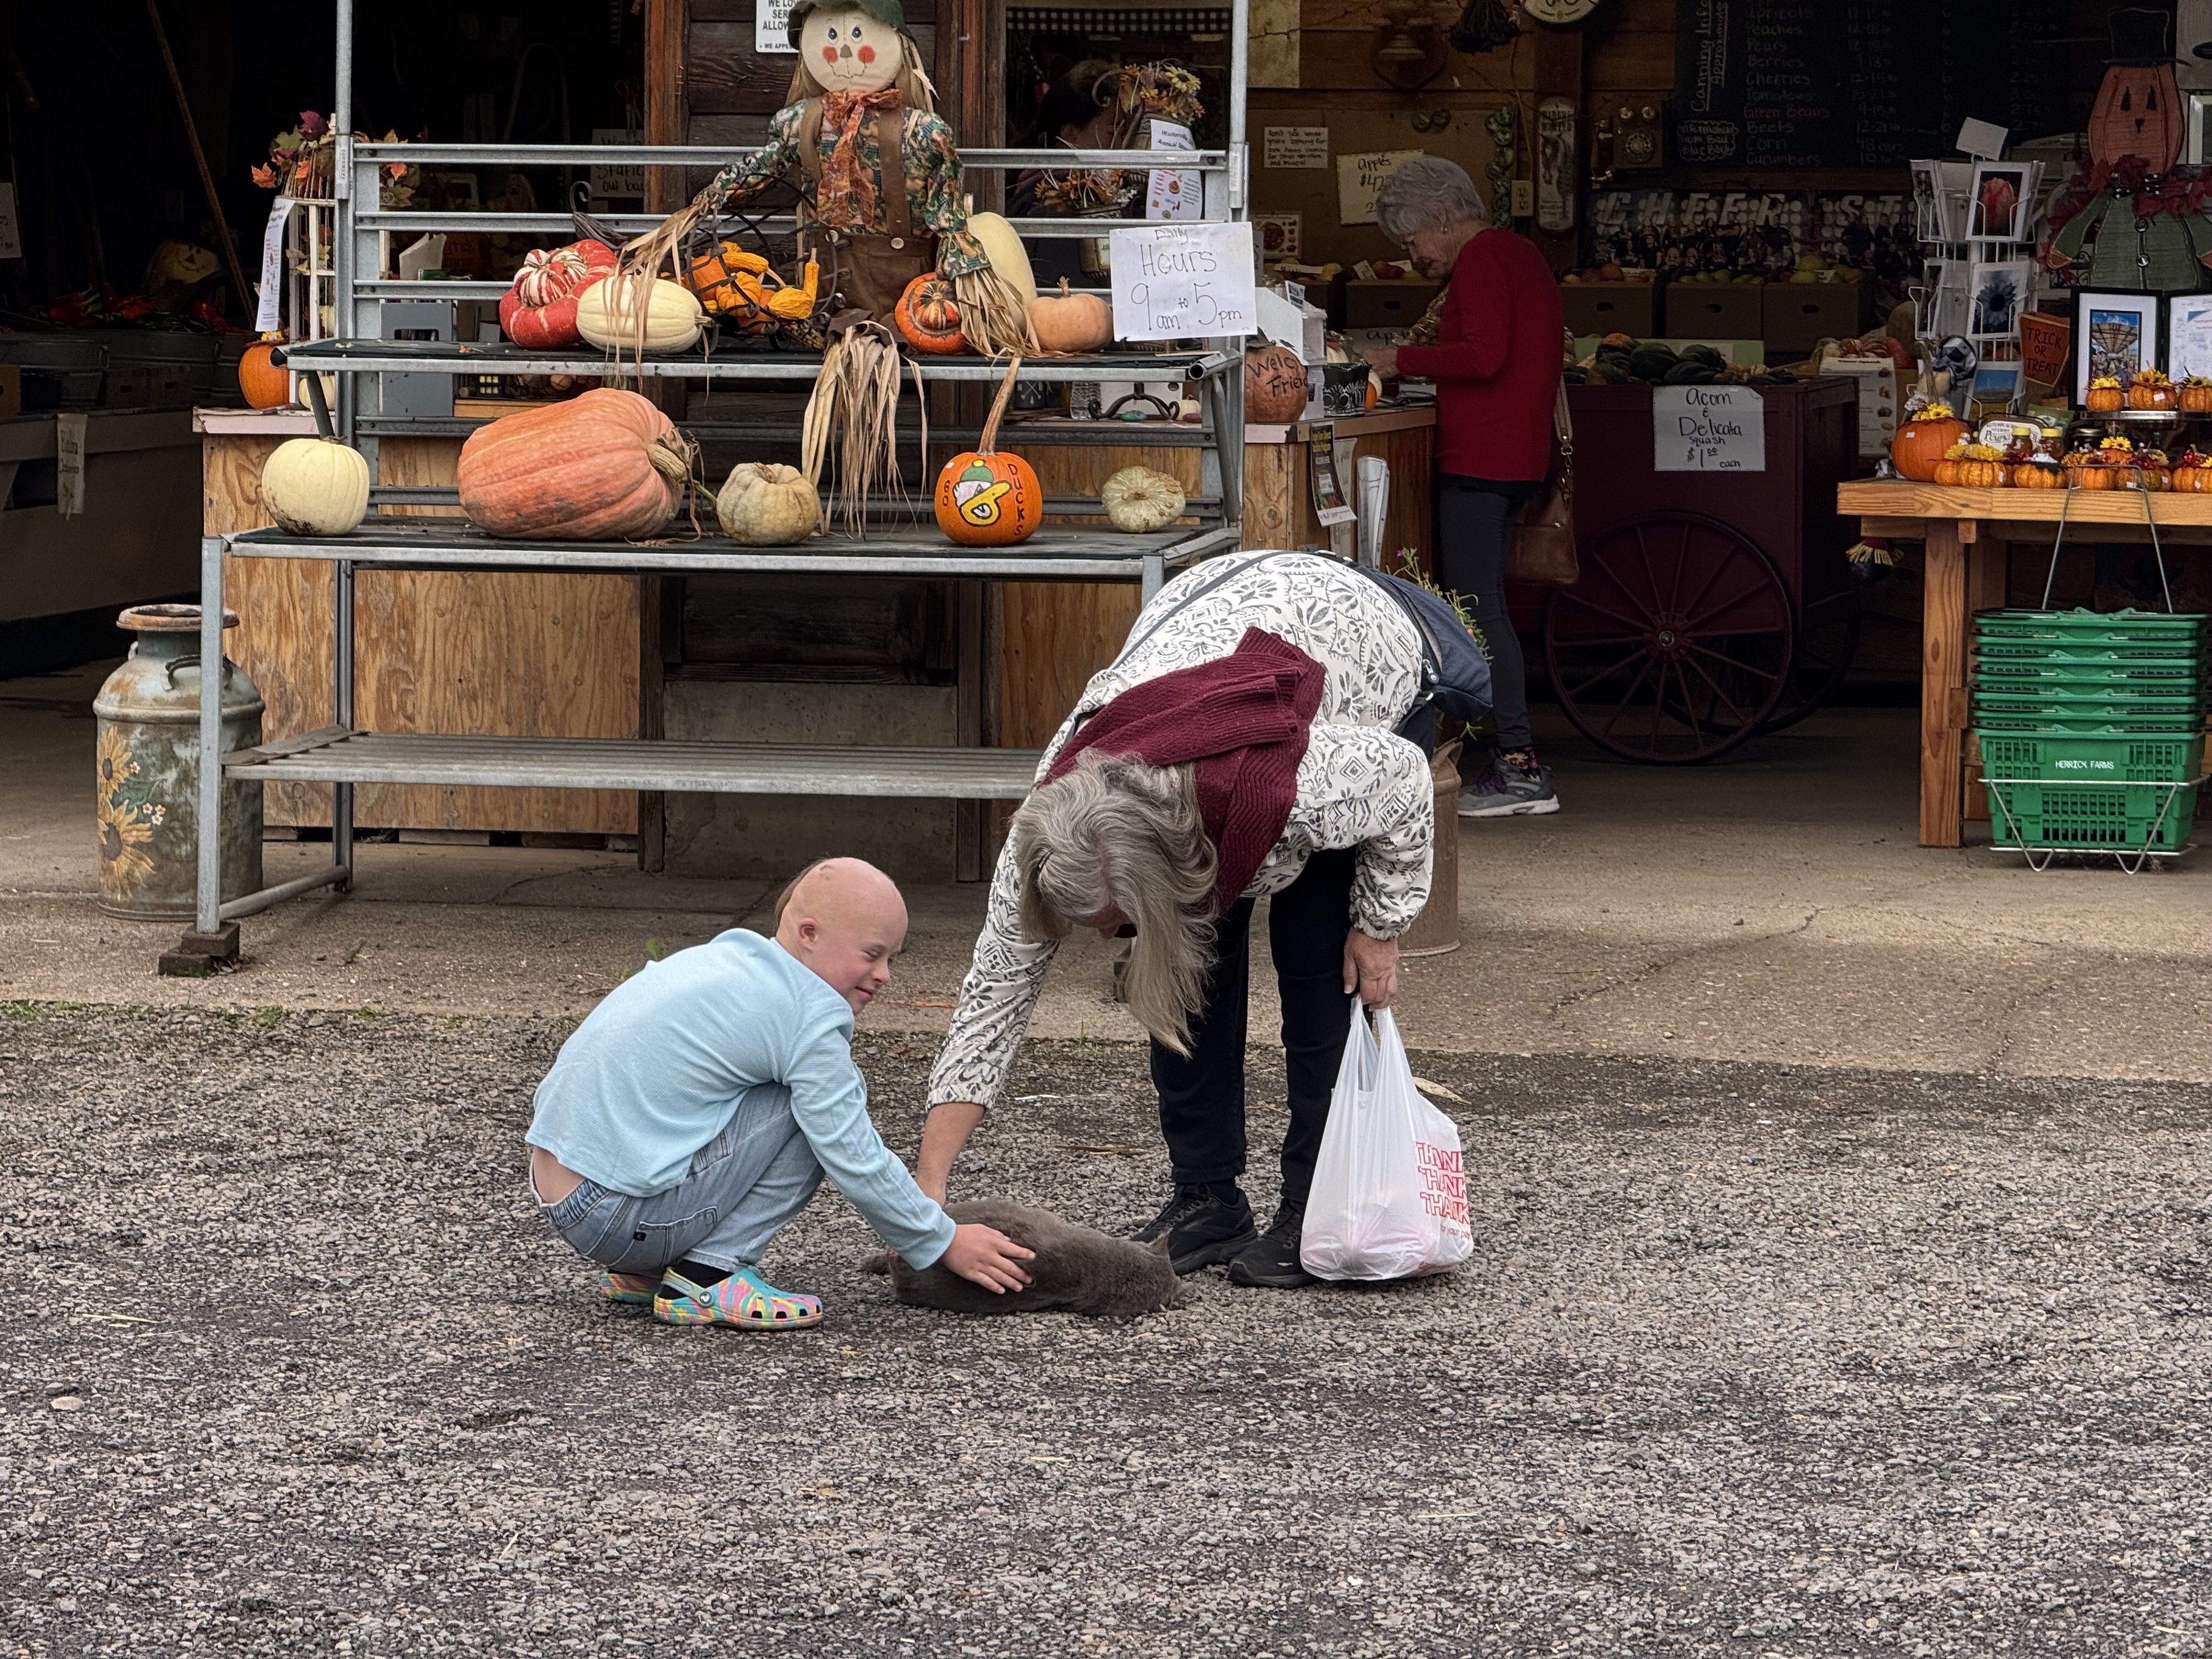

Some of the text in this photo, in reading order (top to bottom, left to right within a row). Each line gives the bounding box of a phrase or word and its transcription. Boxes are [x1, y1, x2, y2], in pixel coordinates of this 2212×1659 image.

[1690, 40, 1715, 111] Canning
[1746, 71, 1811, 86] Cherries
[1743, 105, 1781, 119] Green
[1786, 104, 1830, 119] Beans
[1746, 120, 1795, 133] Beets
[1746, 136, 1787, 151] Corn
[1746, 152, 1821, 166] Cucumbers
[1598, 191, 1786, 226] CHEER
[1154, 227, 1189, 245] Daily
[1140, 244, 1217, 276] Hours
[1178, 297, 1189, 308] to
[2026, 327, 2063, 351] TRICK
[2034, 345, 2047, 359] OR
[2027, 357, 2059, 376] TREAT
[1678, 416, 1742, 437] Delicata
[1719, 459, 1741, 468] each
[942, 479, 951, 507] GO
[1007, 462, 1025, 537] DUCKS
[2055, 760, 2114, 770] HERRICK FARMS
